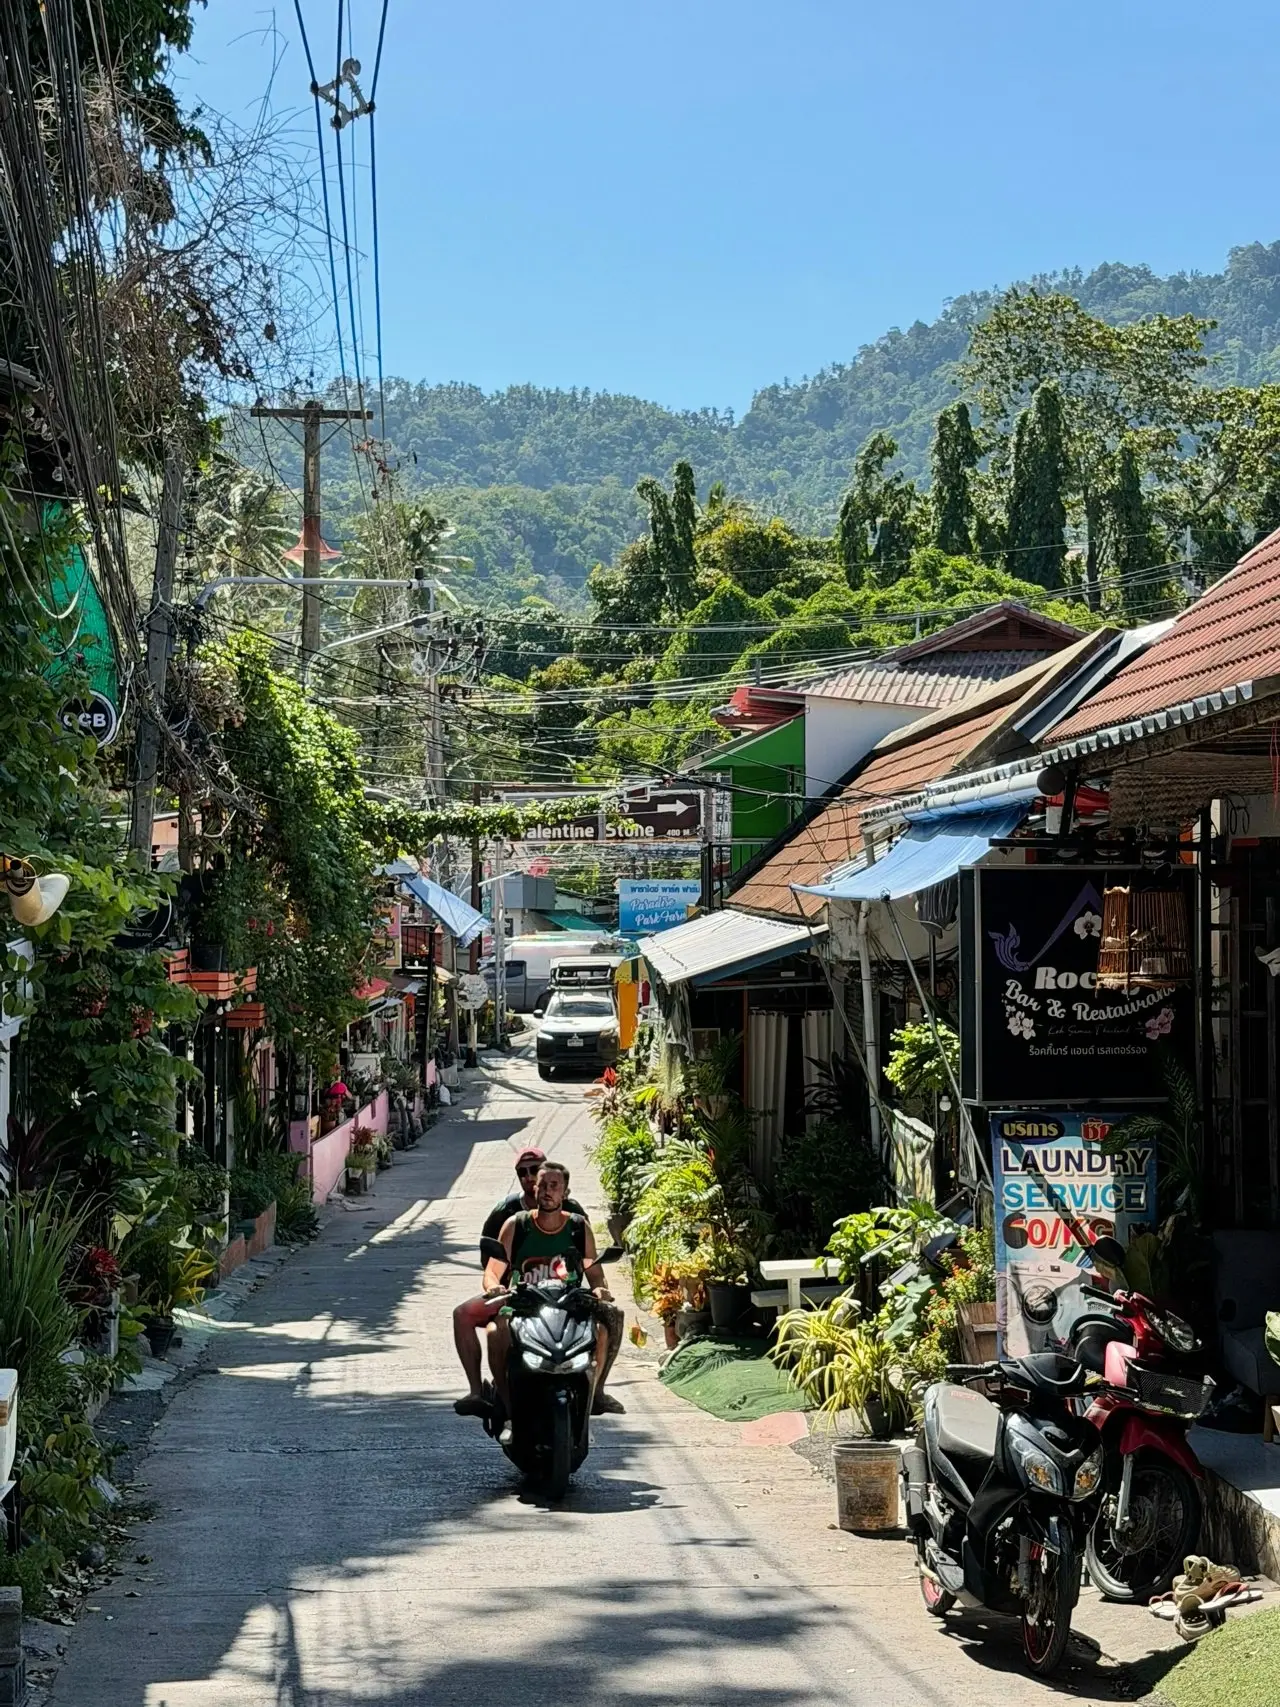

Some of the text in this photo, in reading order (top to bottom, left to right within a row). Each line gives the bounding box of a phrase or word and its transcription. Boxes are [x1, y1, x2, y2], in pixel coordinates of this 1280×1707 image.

[526, 823, 655, 839] alentine Stone
[1034, 966, 1140, 996] Roc
[1005, 979, 1041, 1011] Bar
[1046, 998, 1067, 1019] &
[1003, 1120, 1059, 1137] บริการ
[1002, 1150, 1151, 1174] LAUNDRY
[1004, 1183, 1146, 1209] SERVICE
